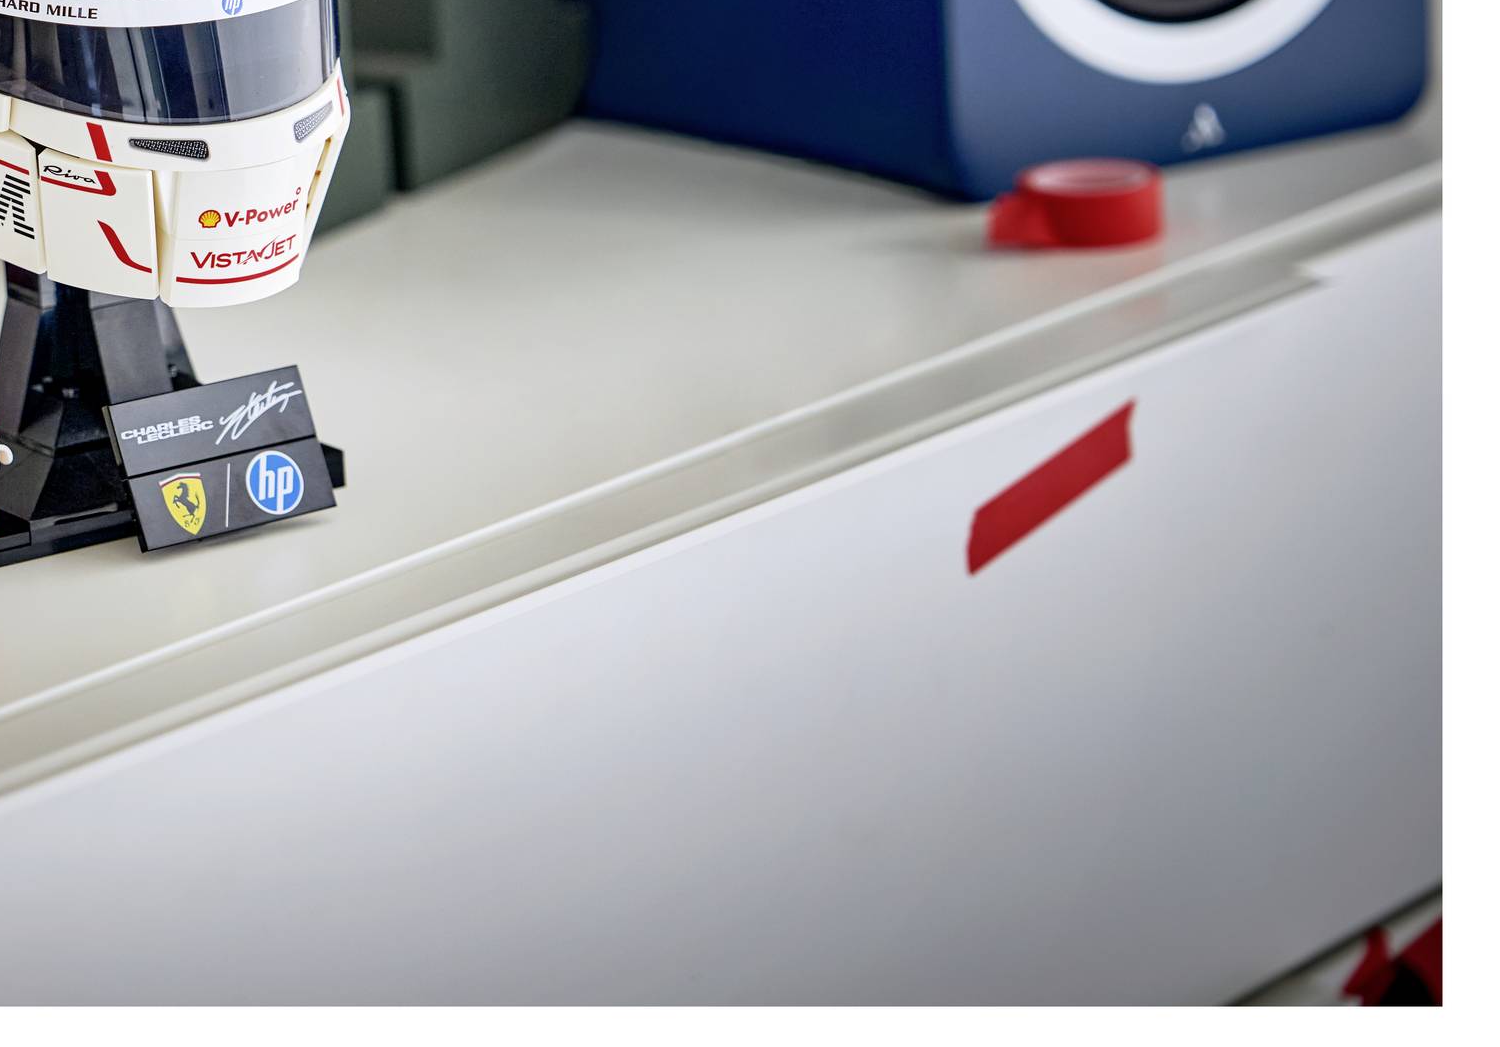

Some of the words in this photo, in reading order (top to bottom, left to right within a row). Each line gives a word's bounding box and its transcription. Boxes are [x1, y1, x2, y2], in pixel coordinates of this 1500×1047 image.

[46, 4, 98, 20] MILLE
[42, 164, 97, 185] Riva
[224, 198, 299, 228] V-Power
[120, 415, 202, 441] CHARLES
[137, 420, 214, 445] LECLERC
[257, 455, 295, 514] hp
